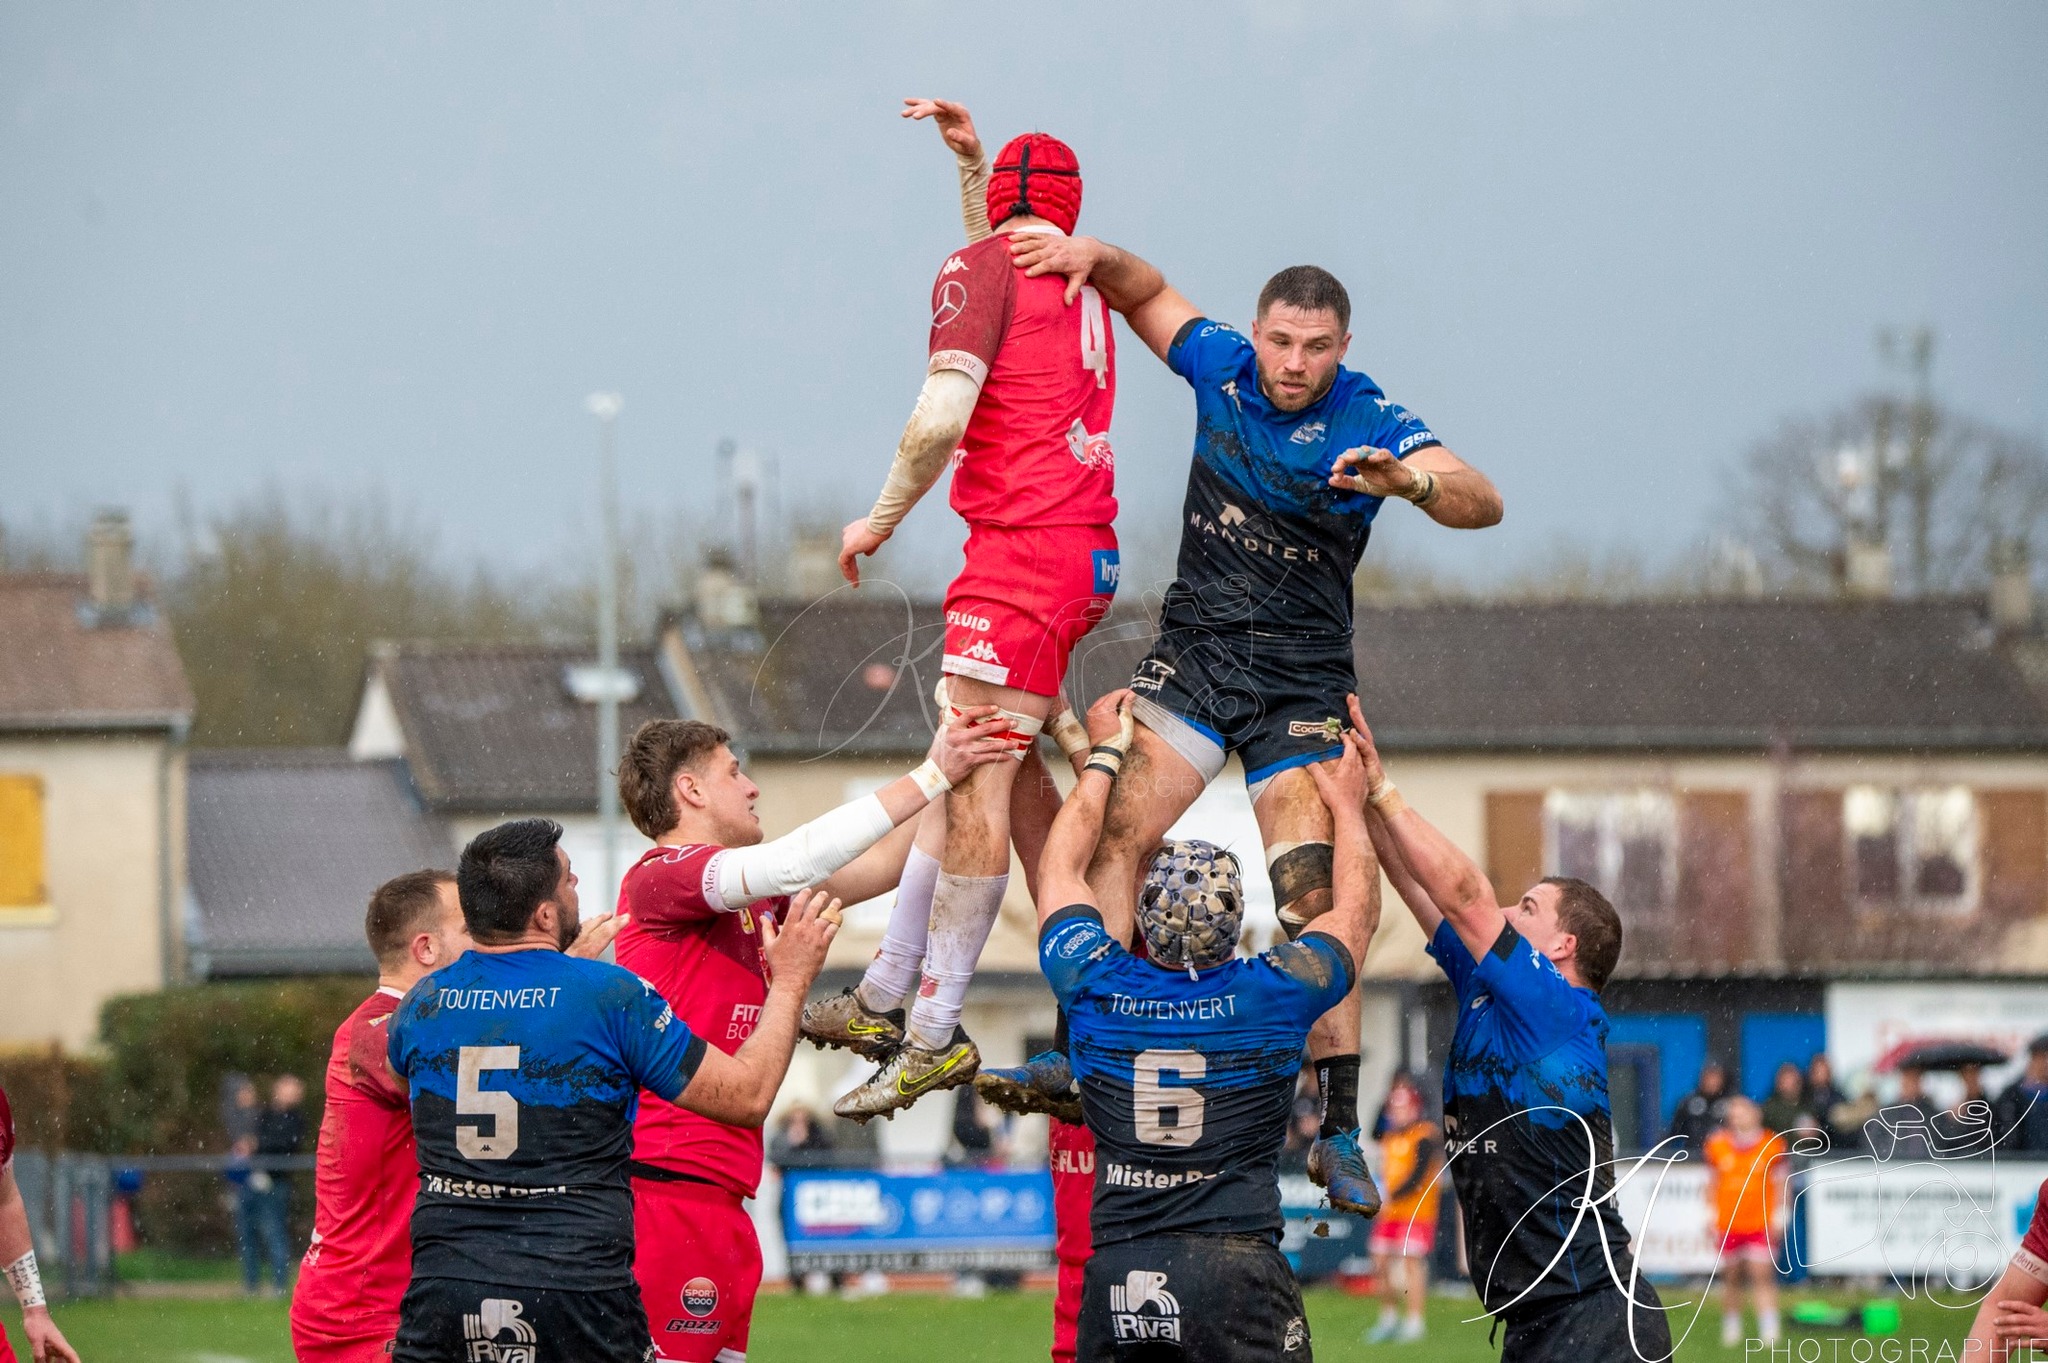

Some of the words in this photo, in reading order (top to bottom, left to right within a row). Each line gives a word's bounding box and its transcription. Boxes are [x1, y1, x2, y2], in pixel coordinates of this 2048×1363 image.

[1080, 285, 1108, 389] 4
[1190, 512, 1320, 562] MANDIER
[438, 987, 561, 1011] TOUTENVERT
[1111, 992, 1236, 1021] TOUTENVERT
[455, 1045, 521, 1160] 5
[1133, 1049, 1207, 1147] 6
[1105, 1163, 1183, 1189] Mister
[684, 1288, 716, 1298] SPORT
[687, 1297, 713, 1306] 2000
[1117, 1314, 1181, 1342] Rival
